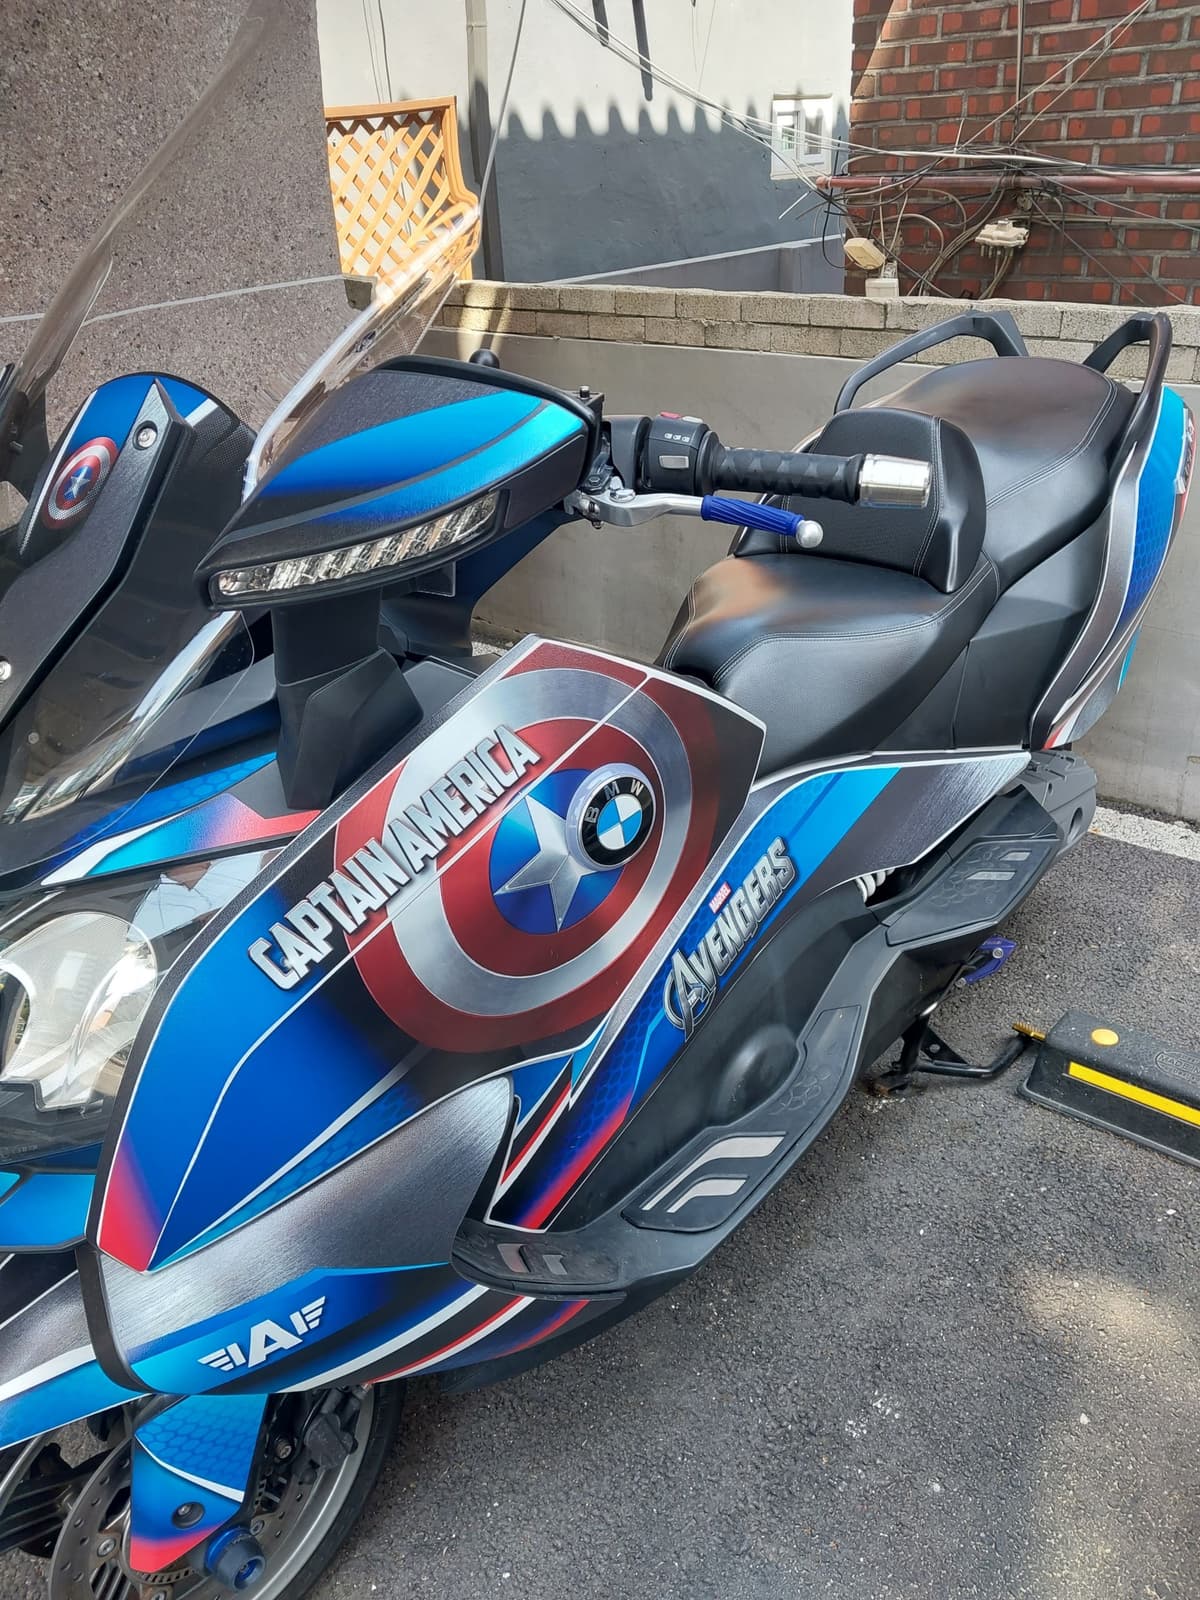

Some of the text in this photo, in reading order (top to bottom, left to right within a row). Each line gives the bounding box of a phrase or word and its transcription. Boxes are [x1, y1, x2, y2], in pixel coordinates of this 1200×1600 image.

[248, 724, 541, 989] CAPTAIN AMERICA
[584, 779, 644, 823] BMW
[663, 836, 796, 1042] AVENGERS
